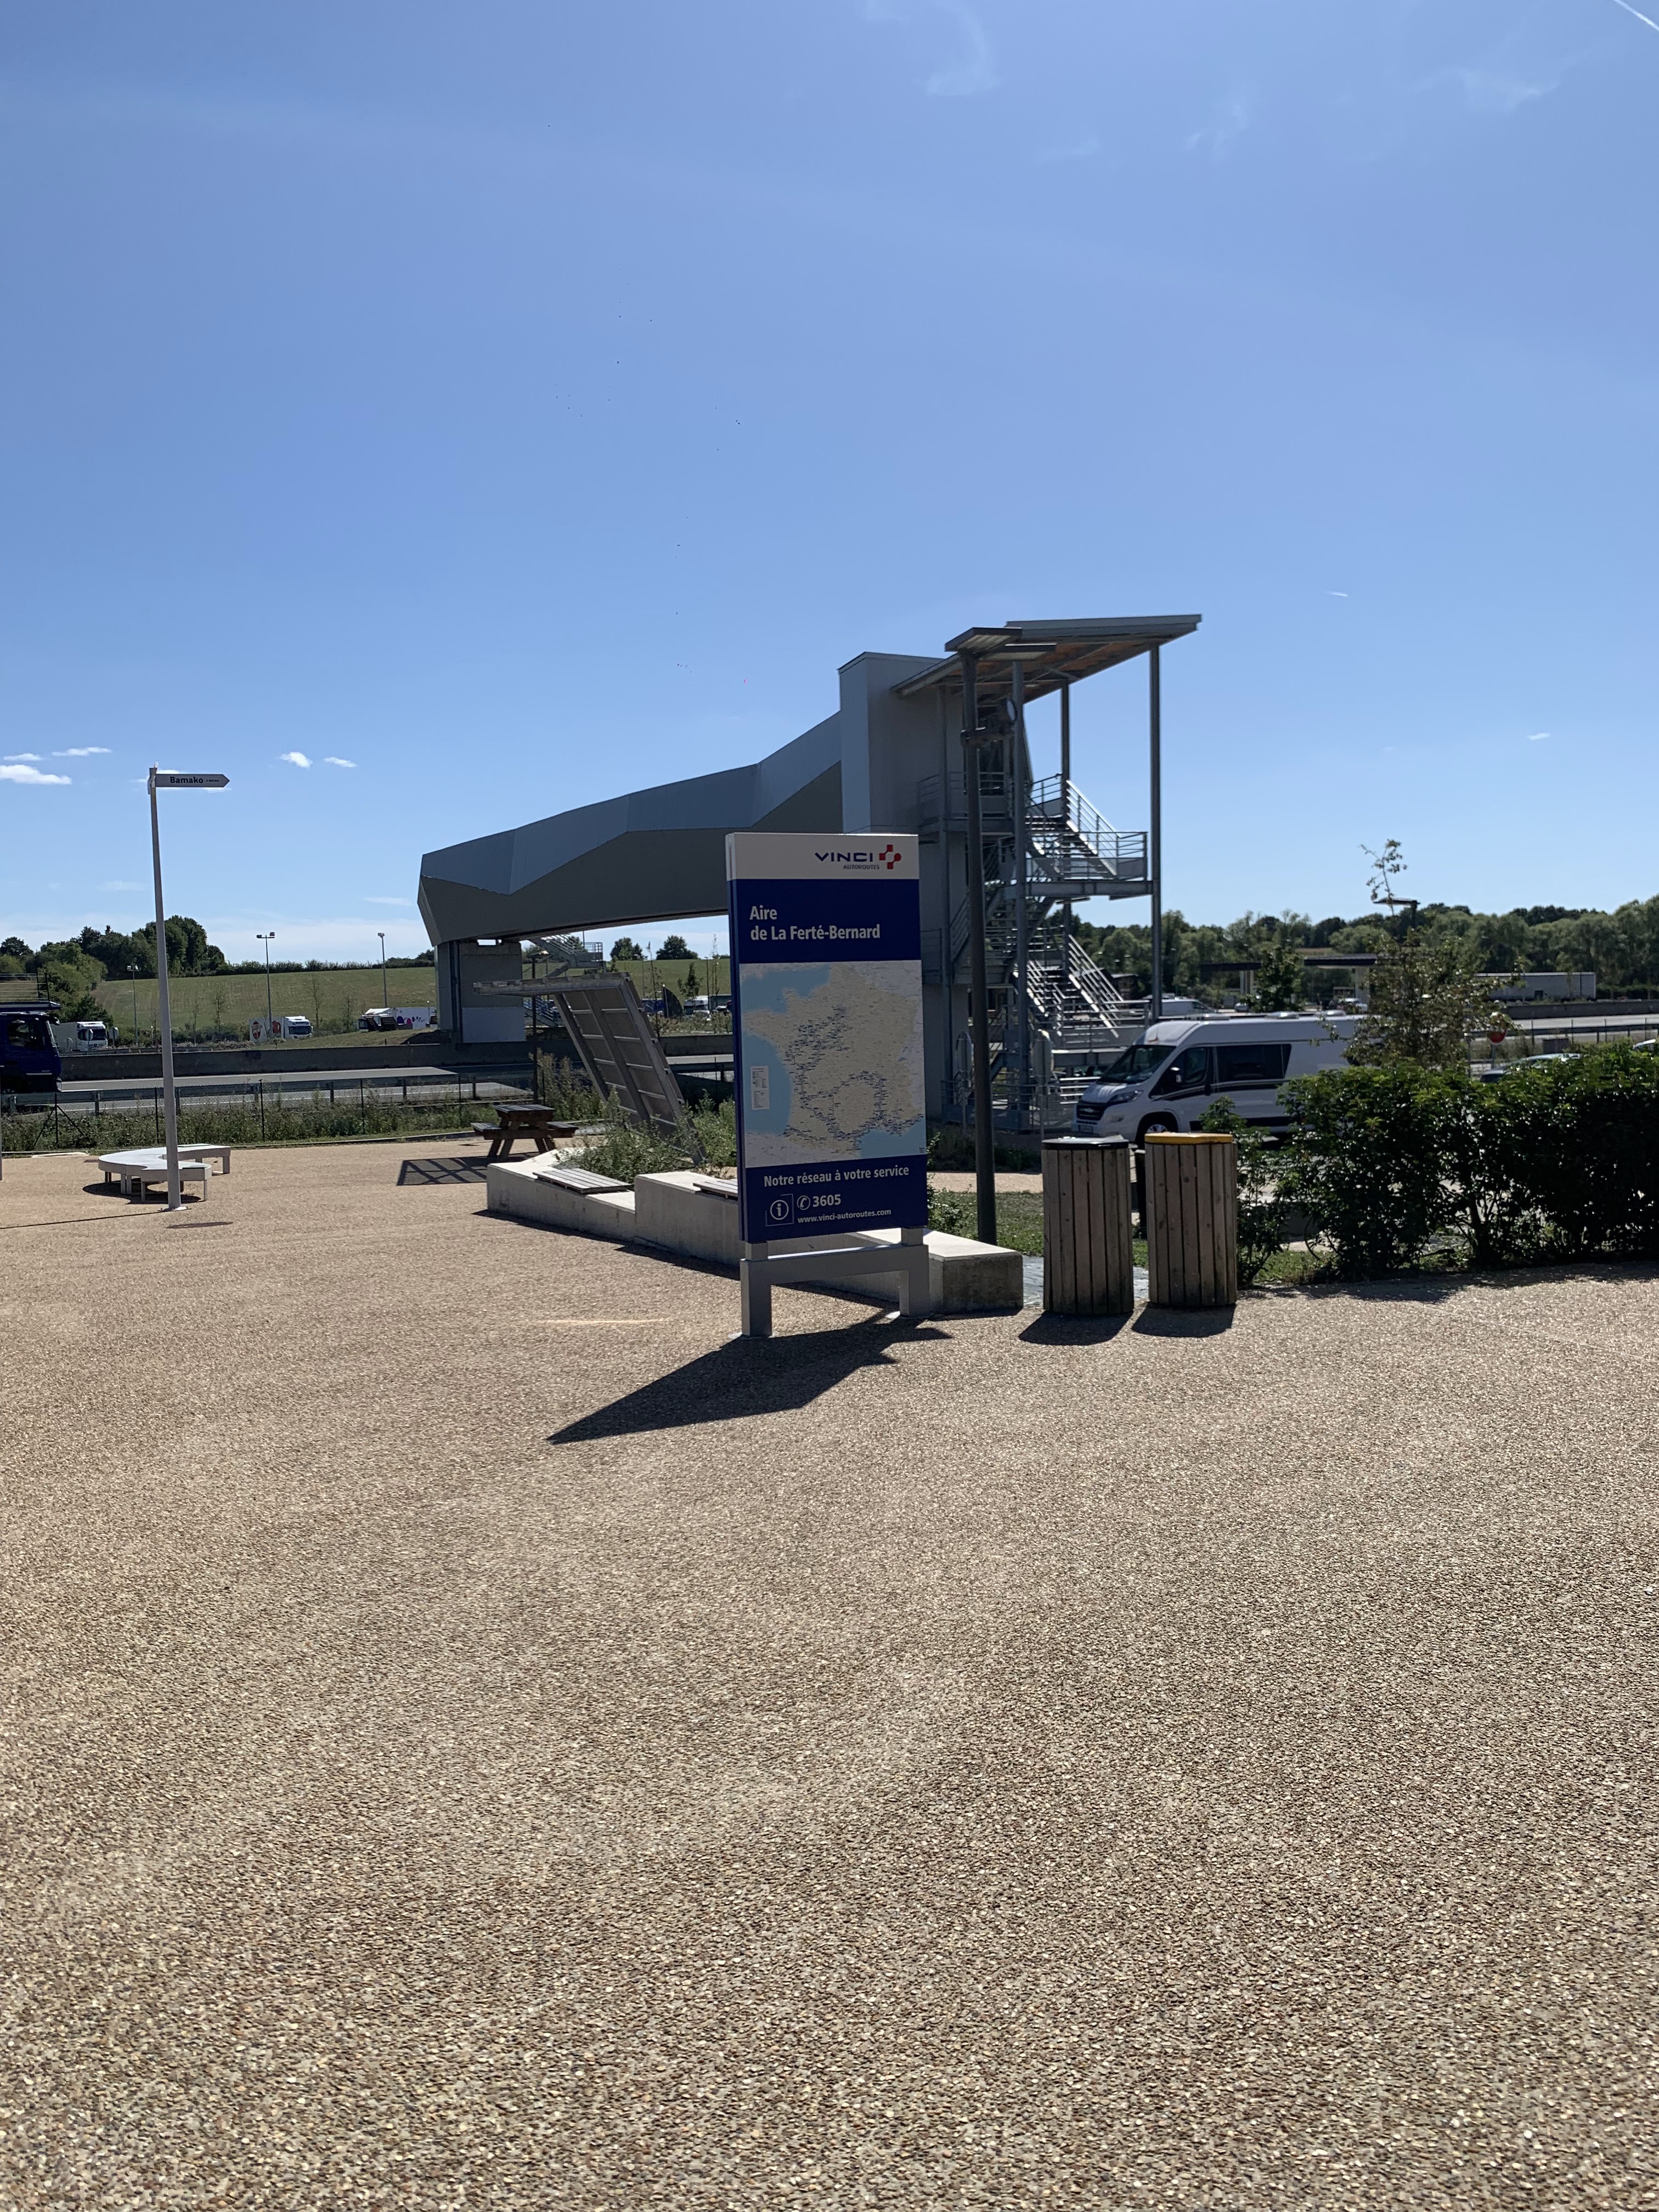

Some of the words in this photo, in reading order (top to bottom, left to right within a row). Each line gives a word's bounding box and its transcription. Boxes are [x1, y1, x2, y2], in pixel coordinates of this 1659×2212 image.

[815, 852, 873, 862] VINCI
[749, 905, 778, 920] Aire
[750, 925, 768, 940] de
[771, 926, 787, 940] La
[790, 923, 881, 940] Ferté-Bernard
[764, 1175, 794, 1187] Notre
[797, 1172, 832, 1184] réseau
[834, 1170, 841, 1181] à
[843, 1169, 871, 1180] votre
[873, 1164, 909, 1178] service
[812, 1194, 842, 1207] 3605
[797, 1209, 891, 1223] www.vinci-autoroutes.com
